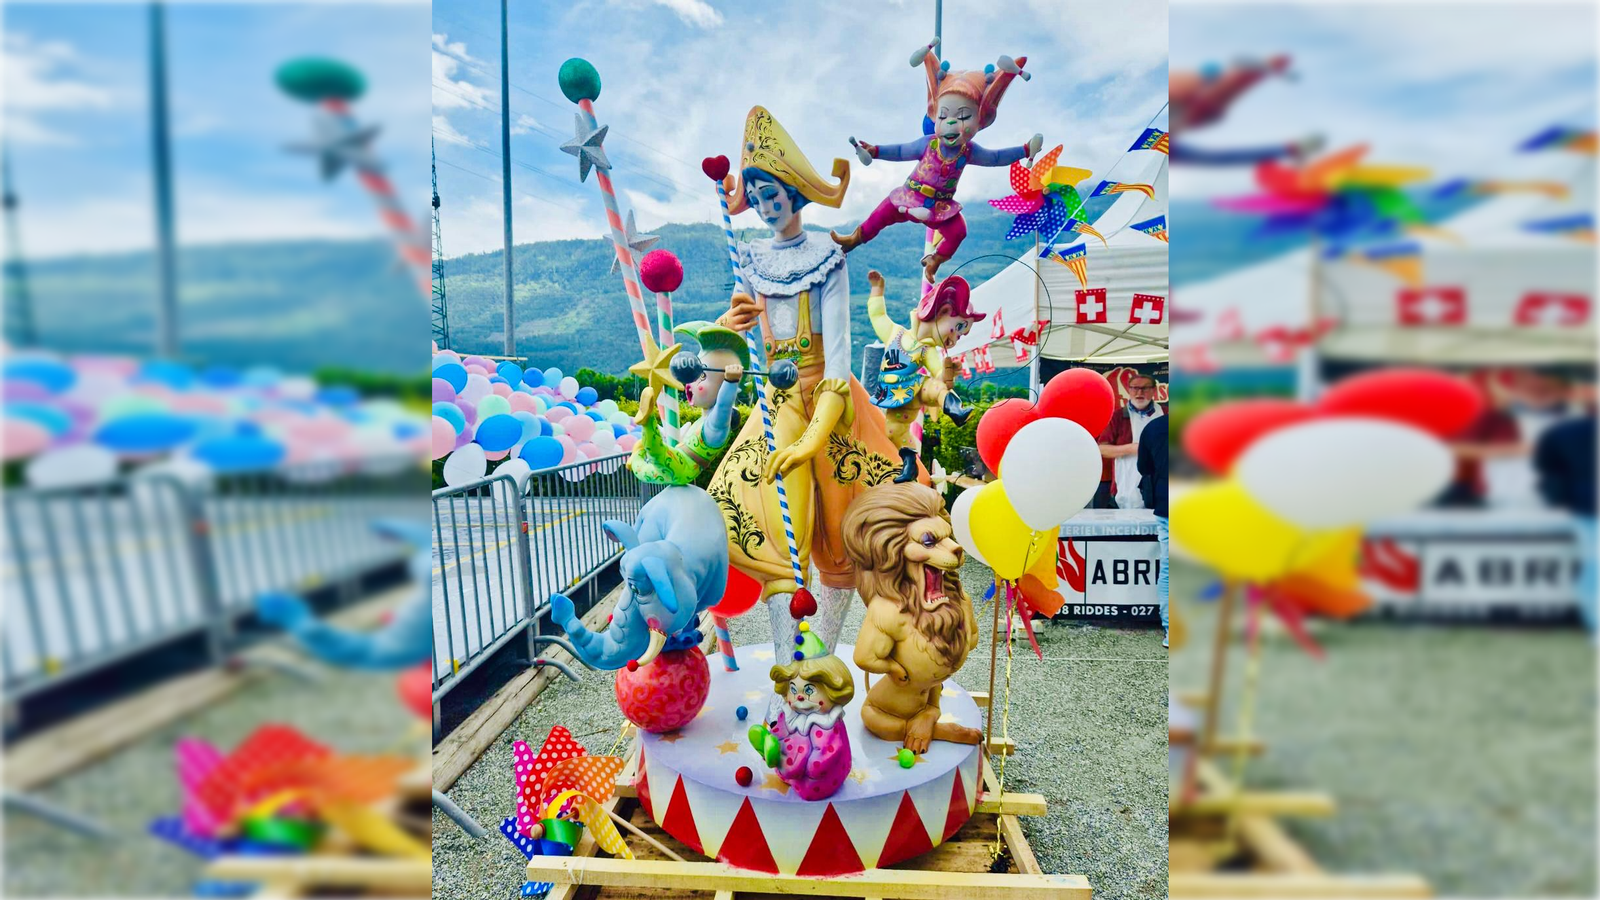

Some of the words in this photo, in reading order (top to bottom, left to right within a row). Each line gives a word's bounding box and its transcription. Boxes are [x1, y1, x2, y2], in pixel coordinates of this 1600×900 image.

[675, 356, 695, 369] 100
[1073, 605, 1119, 615] RIDDES
[1131, 606, 1155, 616] 027
